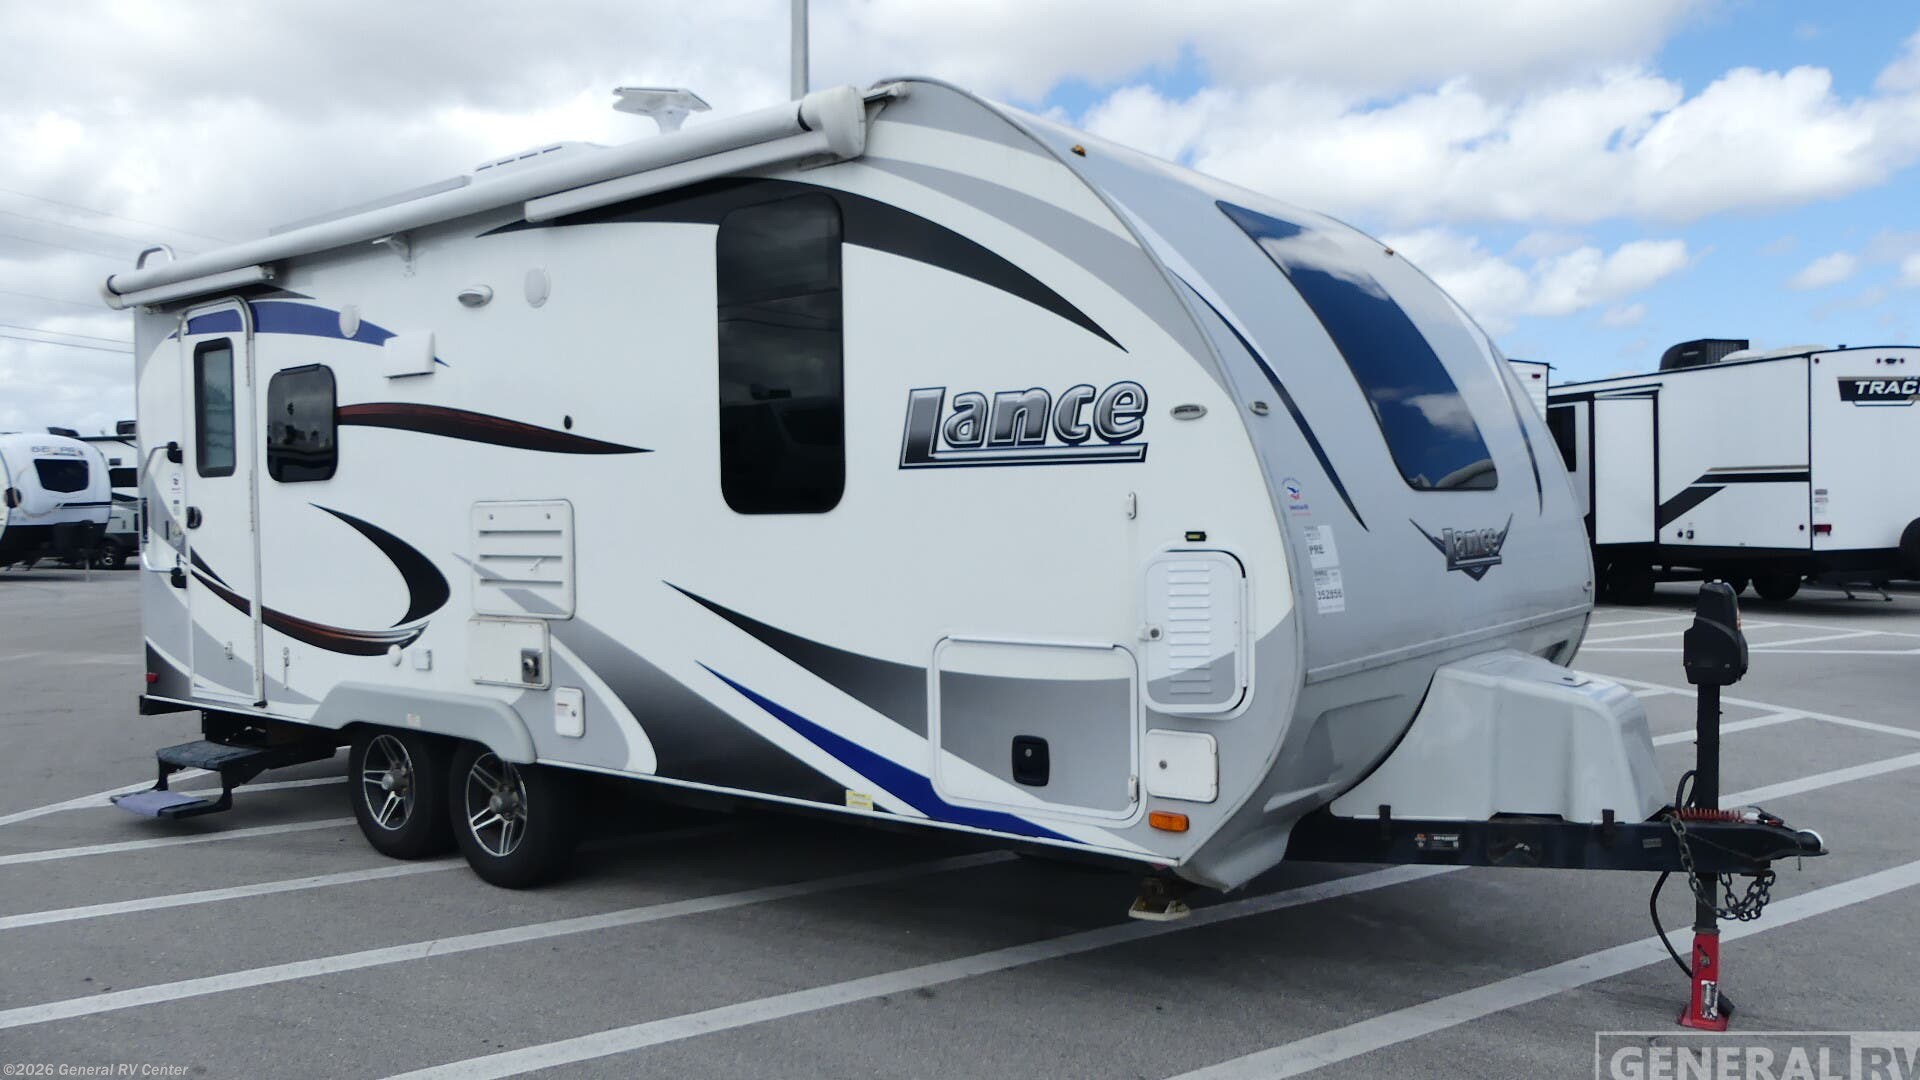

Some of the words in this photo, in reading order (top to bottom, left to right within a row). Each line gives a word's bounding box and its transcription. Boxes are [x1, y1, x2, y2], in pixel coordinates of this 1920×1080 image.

[1855, 381, 1920, 395] TRAC
[899, 380, 1148, 469] Lance
[1442, 528, 1502, 571] Lance
